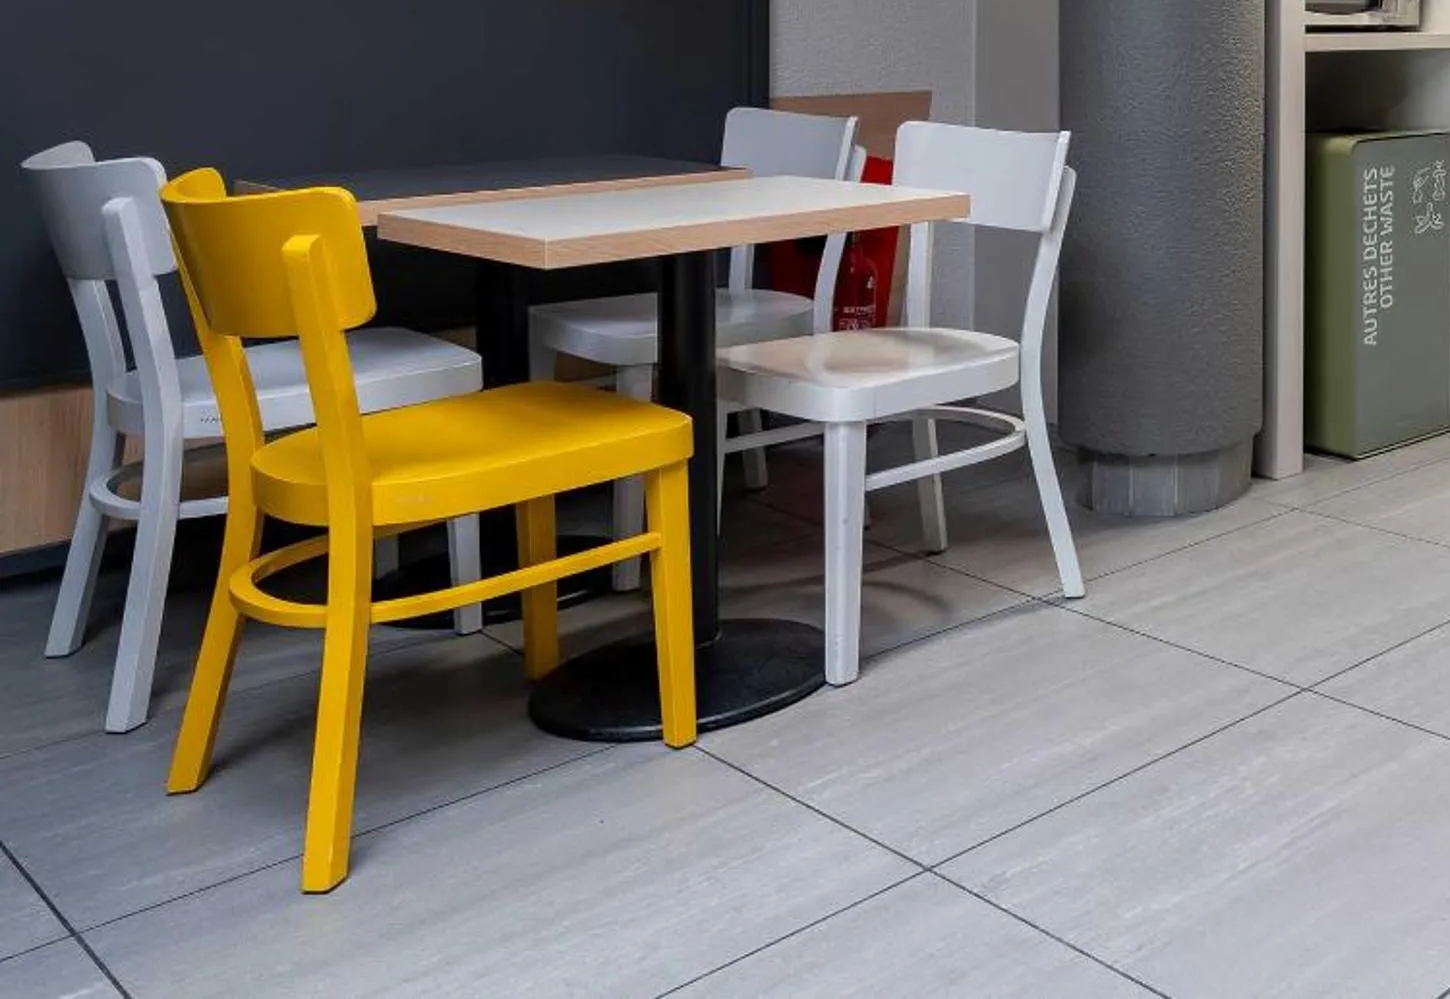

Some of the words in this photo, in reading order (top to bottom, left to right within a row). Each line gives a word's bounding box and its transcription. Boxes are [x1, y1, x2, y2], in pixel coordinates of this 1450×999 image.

[1363, 167, 1379, 260] DECHETS
[1380, 165, 1395, 236] WASTE
[1363, 266, 1379, 346] AUTRES
[1380, 239, 1394, 309] OTHER
